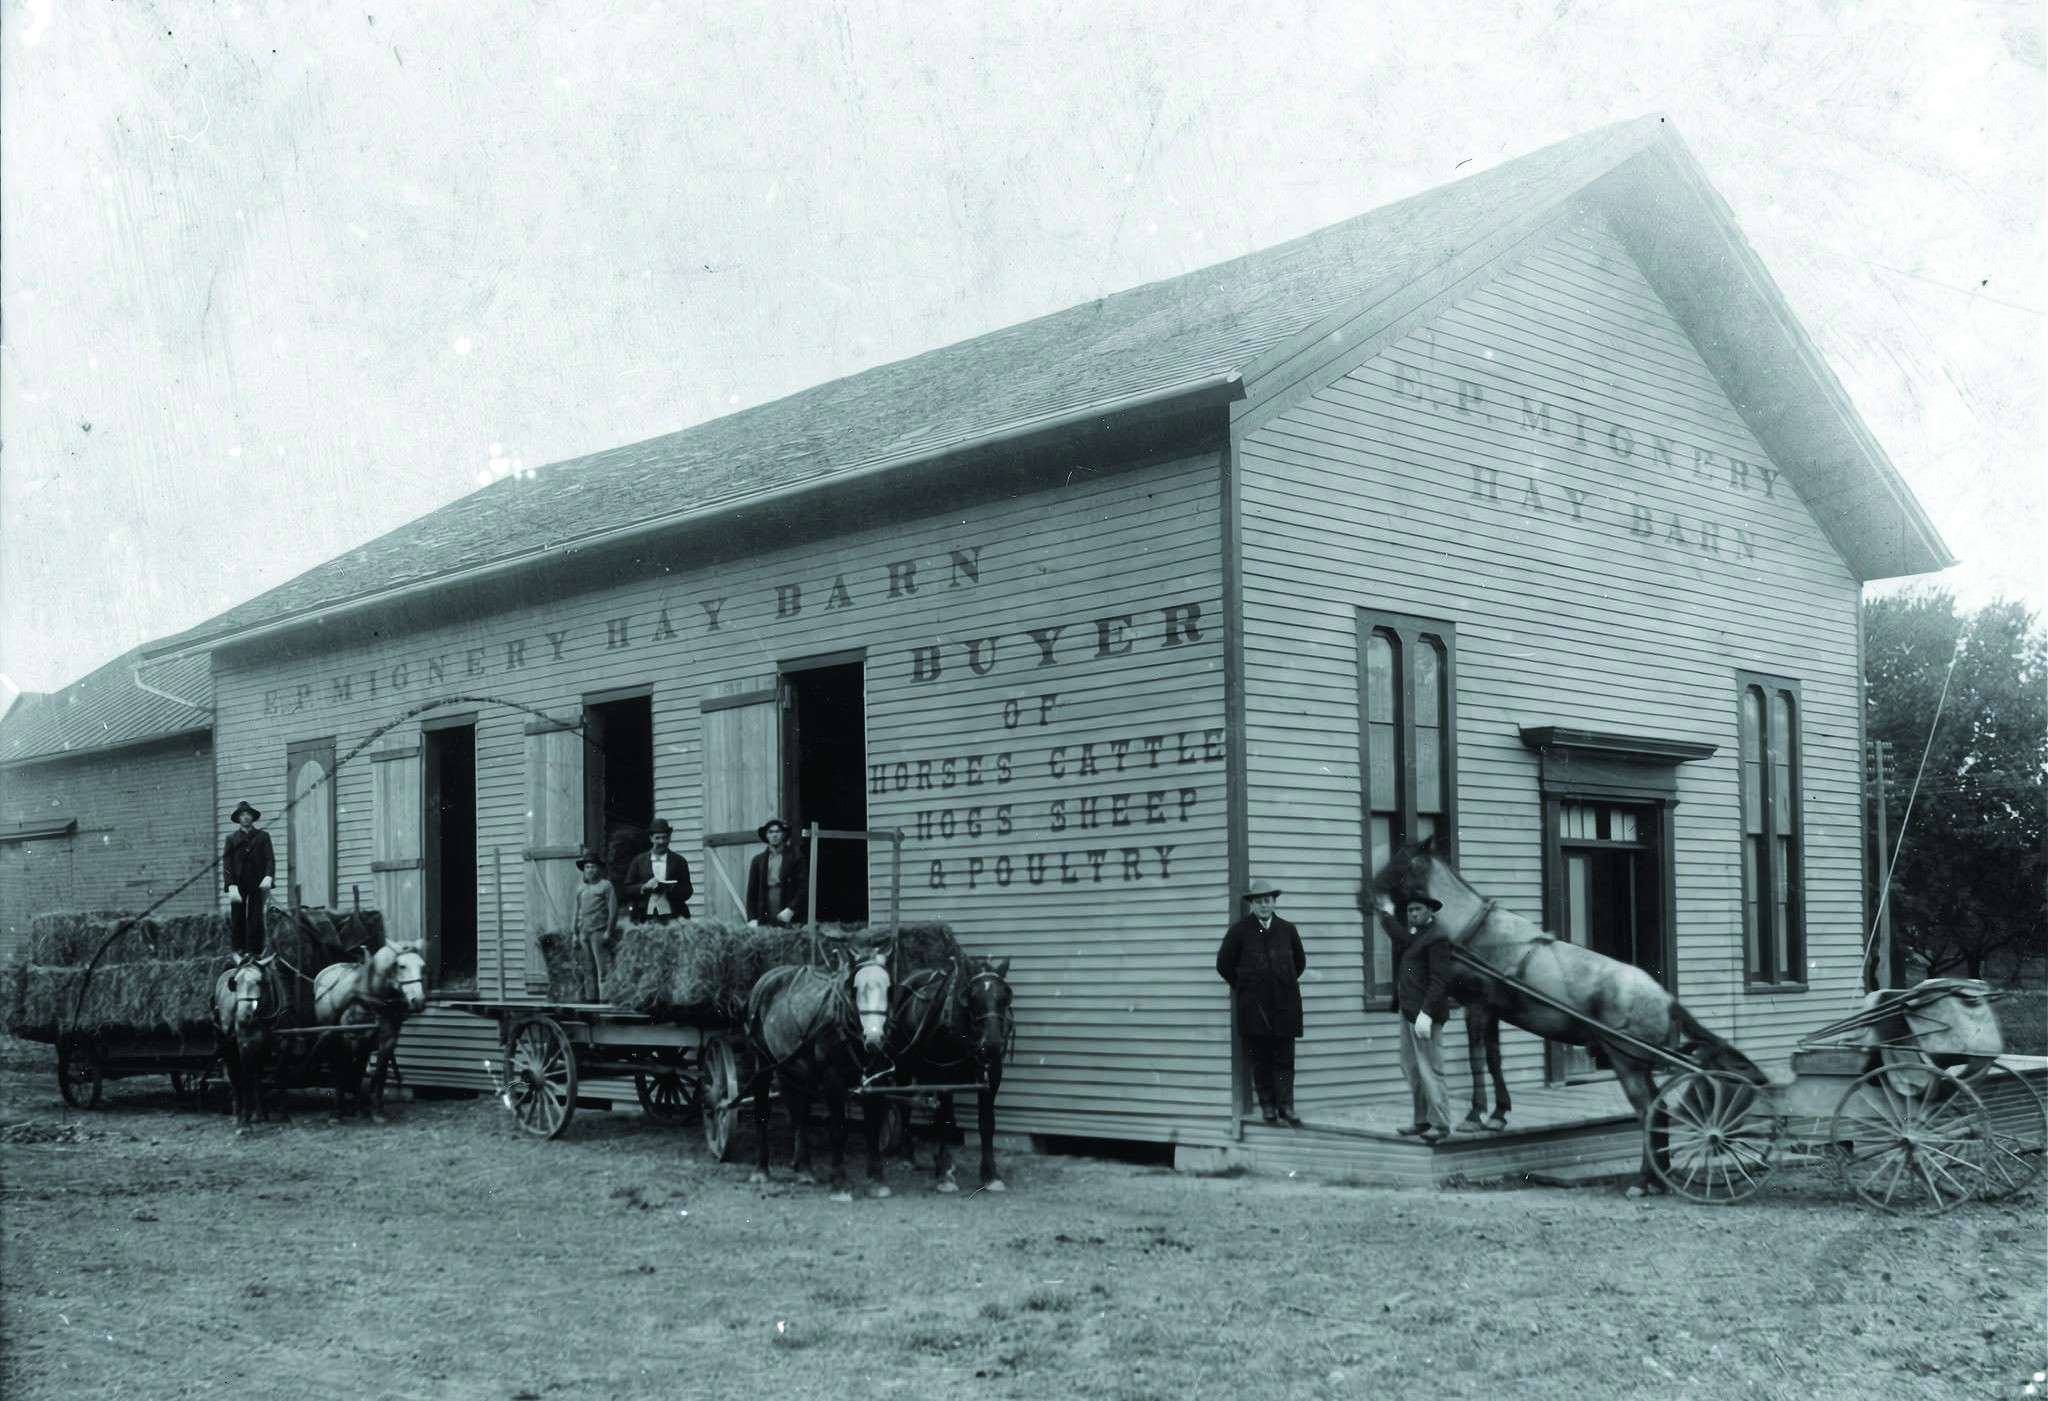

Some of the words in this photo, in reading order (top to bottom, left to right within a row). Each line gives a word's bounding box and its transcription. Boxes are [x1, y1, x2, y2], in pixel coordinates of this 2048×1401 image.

[1519, 396, 1779, 500] MIGNERY
[1469, 462, 1587, 524] HAY
[1629, 510, 1757, 562] BARN
[331, 631, 568, 702] MIGNERY
[605, 598, 729, 650] HAY
[774, 546, 983, 619] BARN
[909, 603, 1204, 683] BUYER
[1003, 692, 1059, 730] OF
[869, 751, 1014, 794] HORSES
[1049, 727, 1226, 779] CATTLE
[916, 802, 1014, 841] HOGS
[1049, 786, 1198, 832] SHEEP
[928, 857, 946, 890] &
[968, 844, 1177, 889] POULTRY
